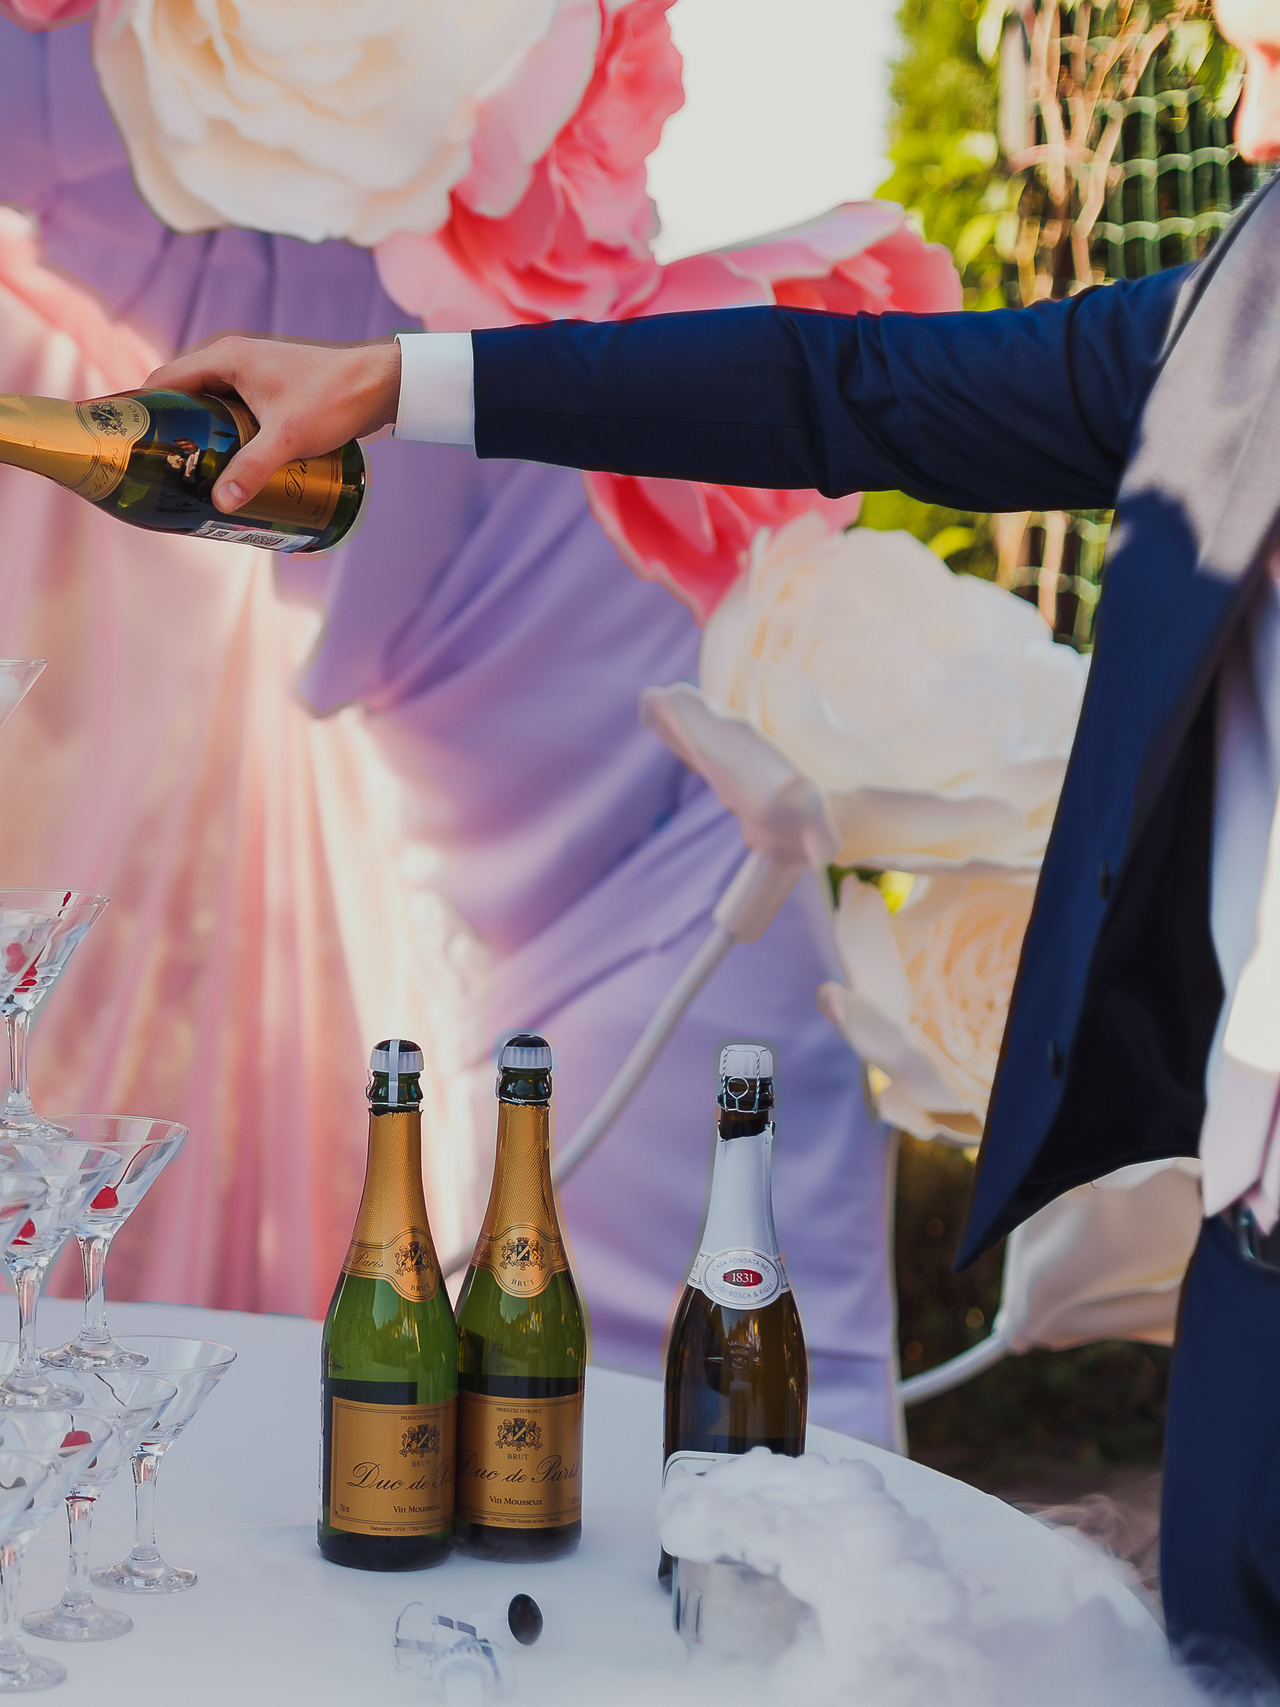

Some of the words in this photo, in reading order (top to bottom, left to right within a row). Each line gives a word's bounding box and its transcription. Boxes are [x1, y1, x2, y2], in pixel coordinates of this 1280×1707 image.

[127, 404, 140, 423] BRUT
[98, 448, 119, 484] Paris
[284, 458, 308, 505] Du
[352, 1251, 384, 1268] Paris
[712, 1260, 727, 1272] CASA
[729, 1257, 760, 1265] FONDATA
[761, 1263, 772, 1274] NEL
[511, 1279, 535, 1287] BRUT
[732, 1272, 753, 1283] 1831
[410, 1283, 431, 1292] BRUT
[711, 1281, 727, 1293] LUIGI
[760, 1283, 773, 1295] FIGLI
[411, 1459, 432, 1467] BRUT
[458, 1449, 501, 1480] Duc
[501, 1468, 529, 1483] de
[531, 1454, 580, 1483] Paris
[347, 1461, 405, 1490] Duc
[405, 1475, 429, 1490] de
[489, 1495, 502, 1504] Vin
[504, 1497, 543, 1506] Mousseux
[393, 1505, 406, 1514] Vin
[408, 1504, 440, 1513] Mousseux
